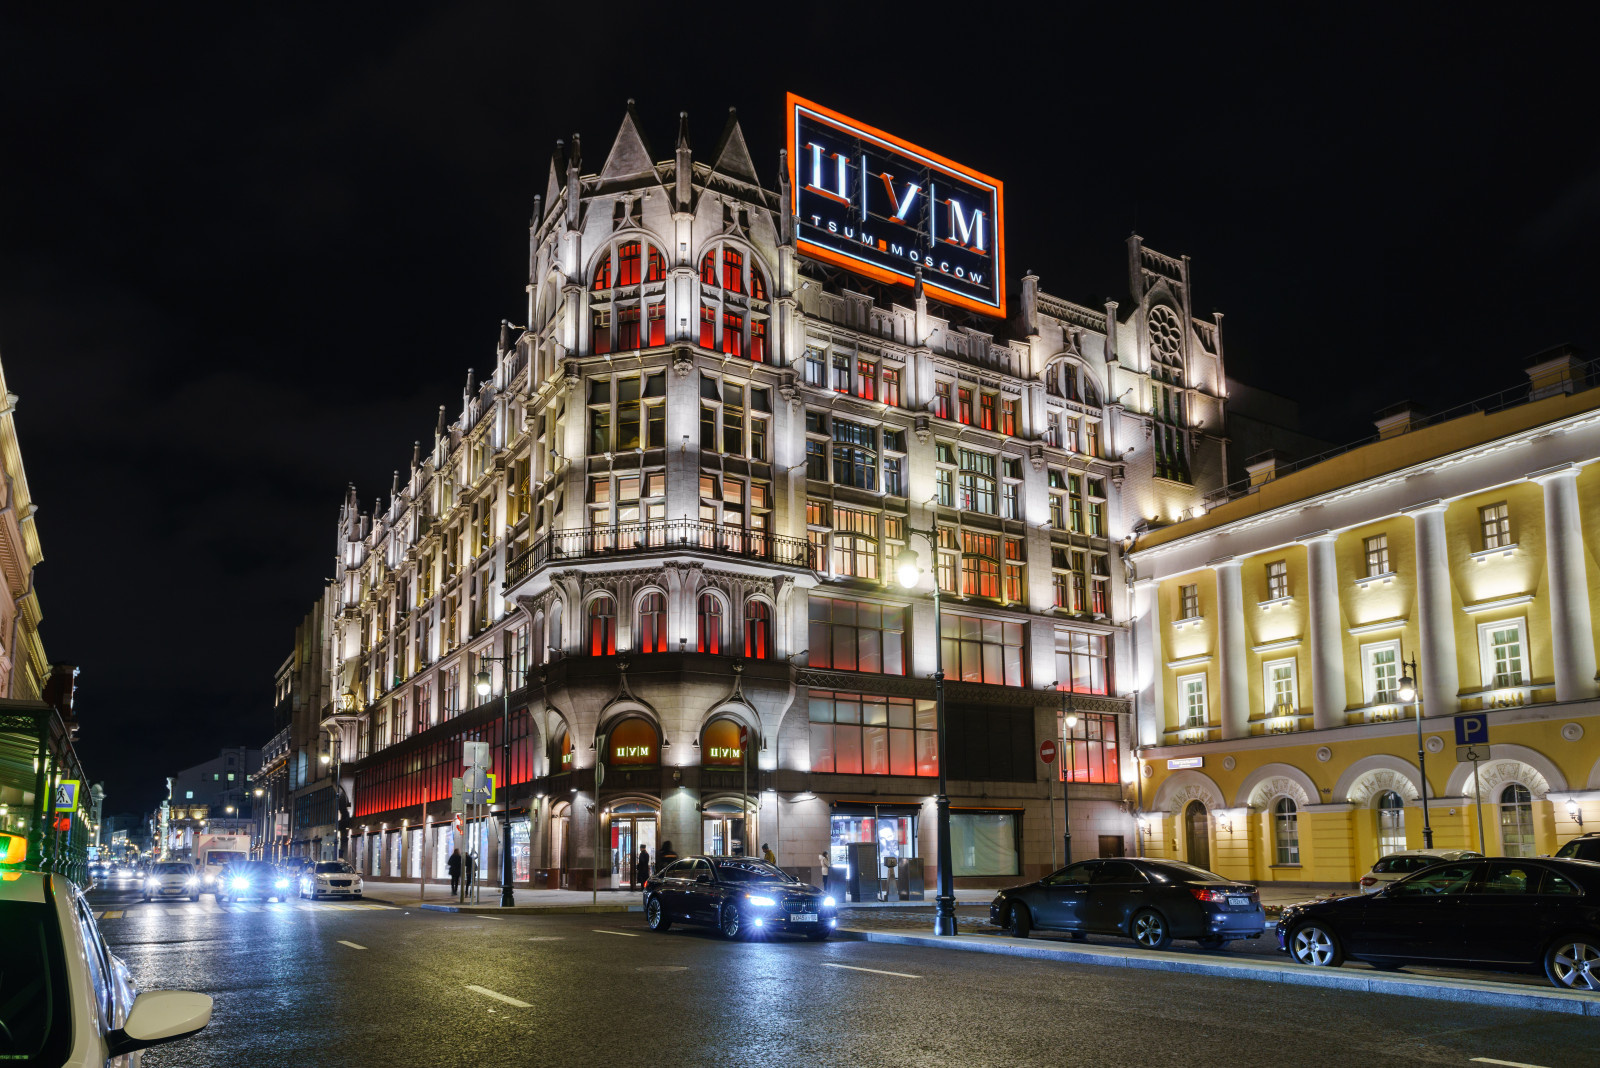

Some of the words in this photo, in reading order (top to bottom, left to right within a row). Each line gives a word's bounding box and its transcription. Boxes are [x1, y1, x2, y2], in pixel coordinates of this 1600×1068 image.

[811, 215, 874, 247] TSUM
[890, 244, 983, 285] MOSCOW
[1463, 718, 1482, 742] P
